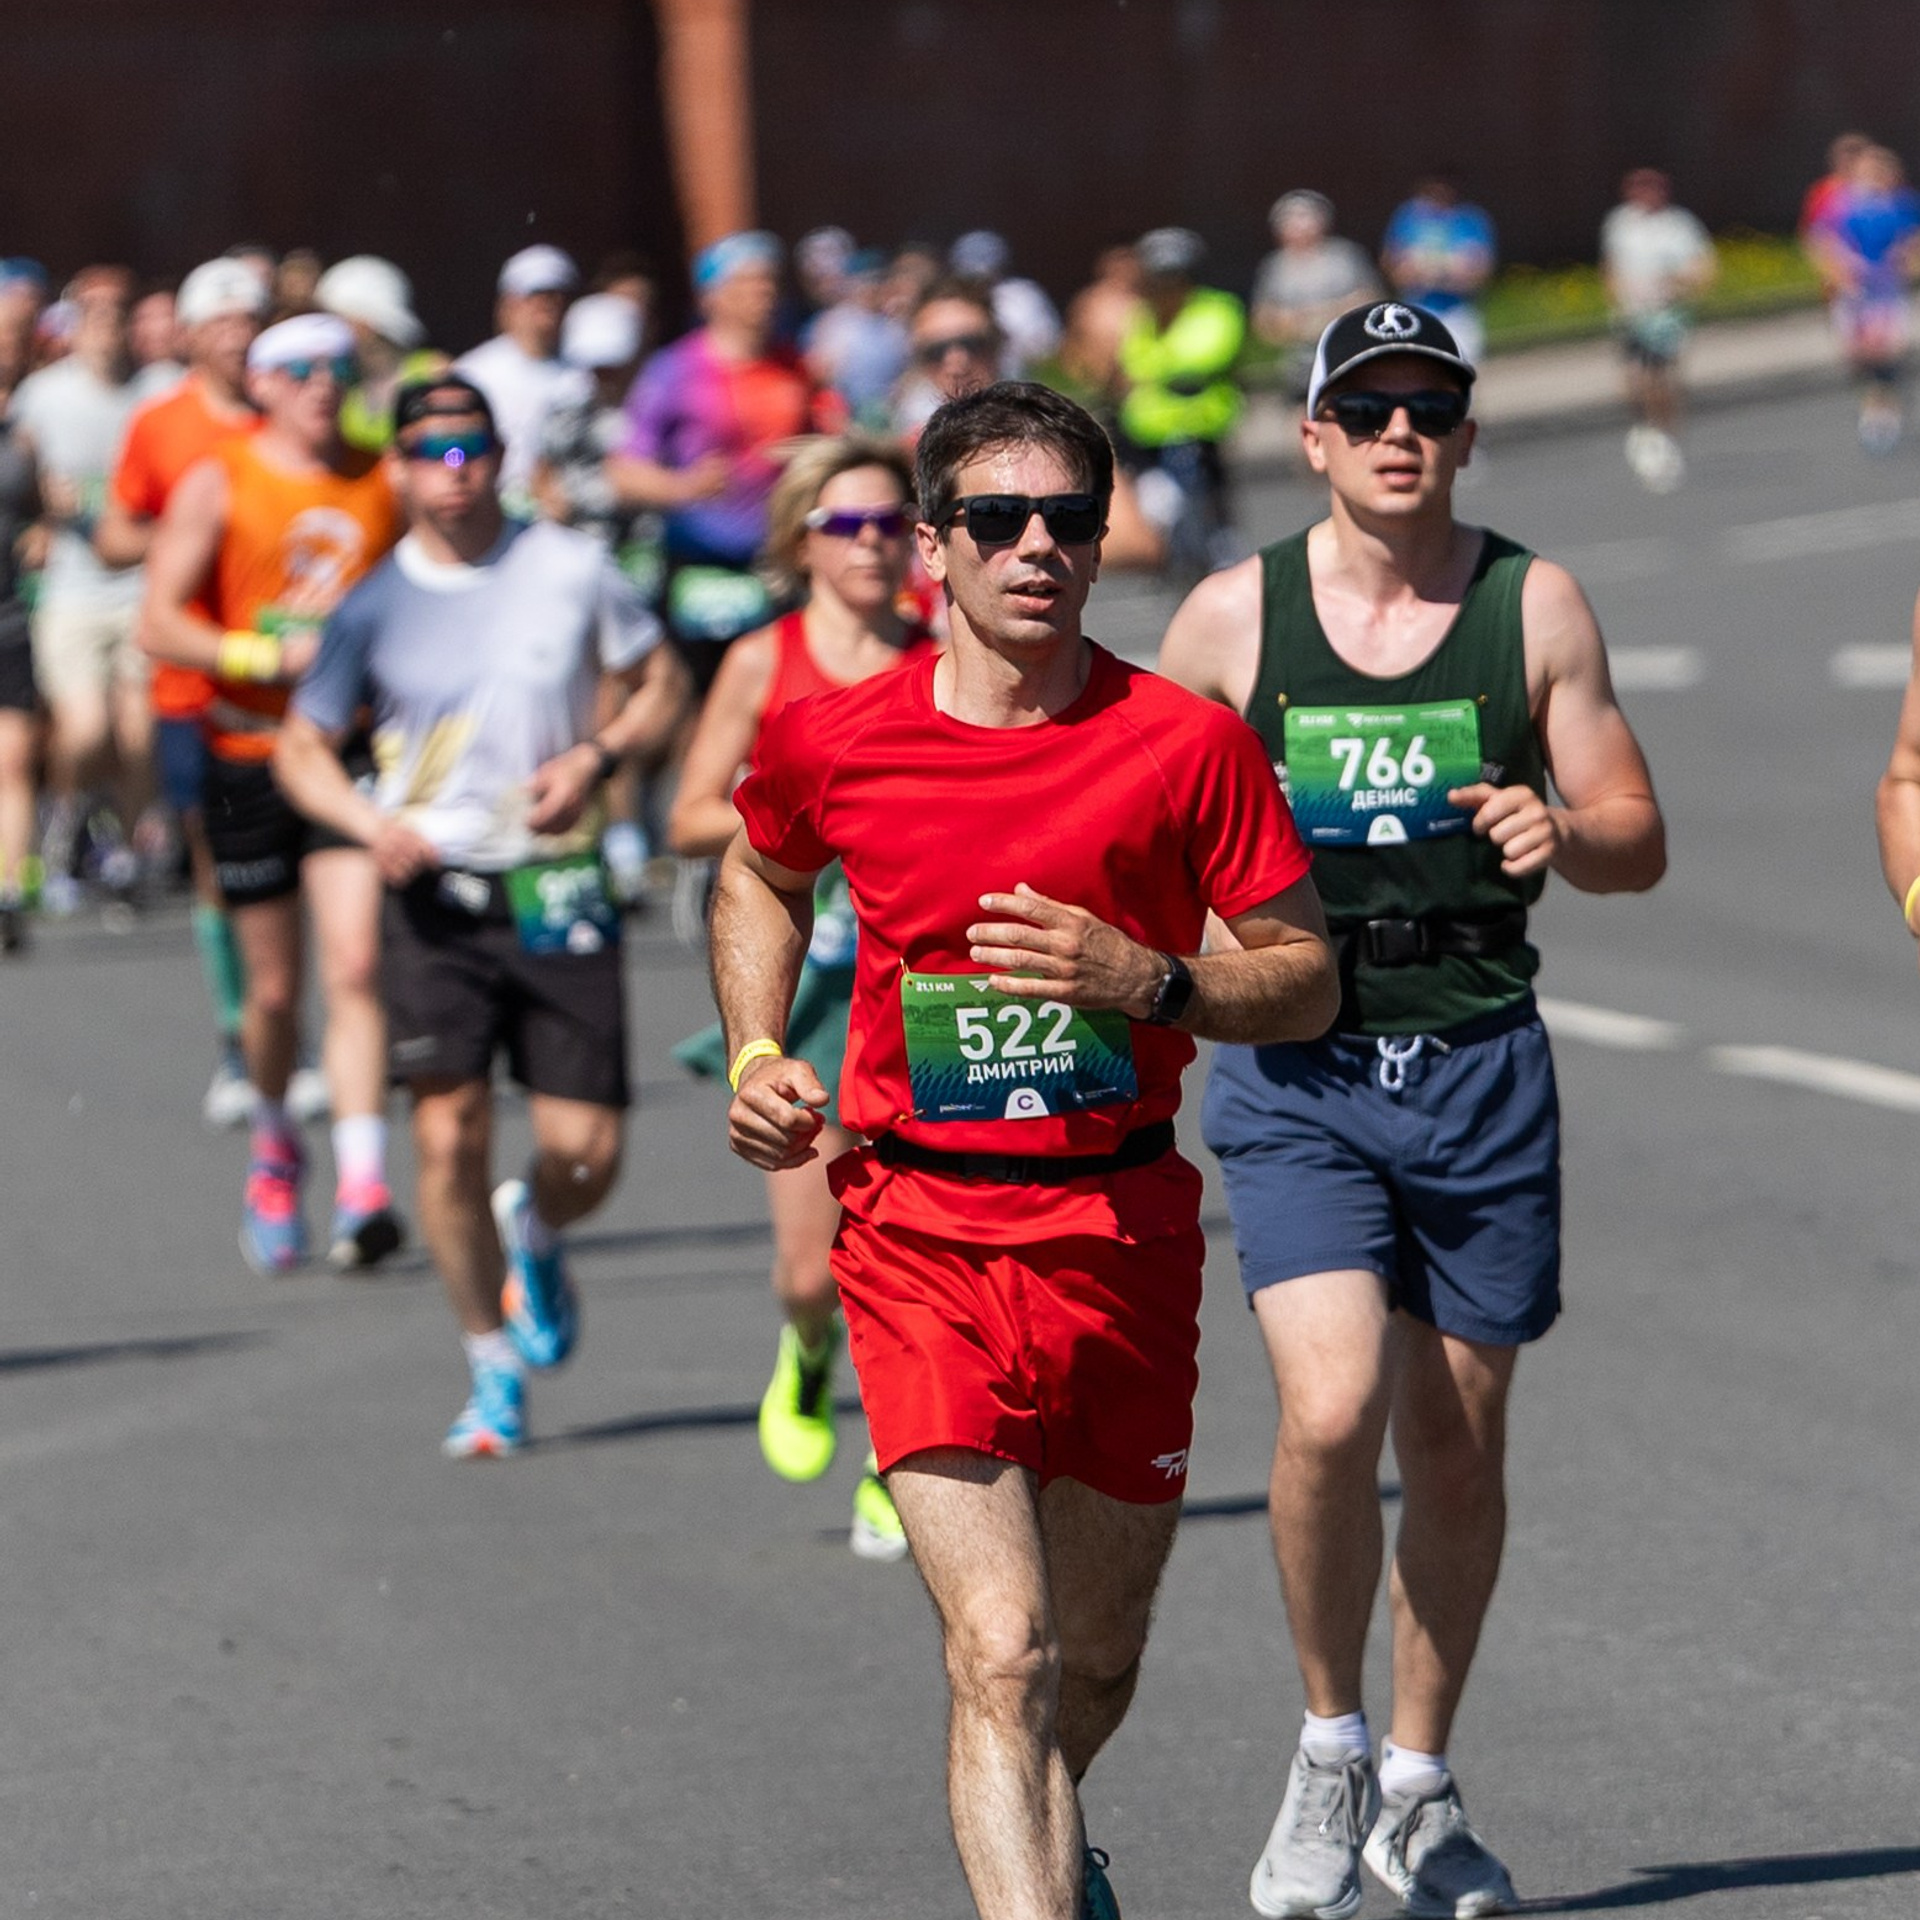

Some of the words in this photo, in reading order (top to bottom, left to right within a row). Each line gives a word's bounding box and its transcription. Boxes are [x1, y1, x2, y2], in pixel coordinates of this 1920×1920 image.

[1330, 734, 1435, 791] 766
[1351, 787, 1419, 813] ДЕНИС
[955, 1000, 1077, 1061] 522
[967, 1051, 1075, 1085] ДМИТРИЙ
